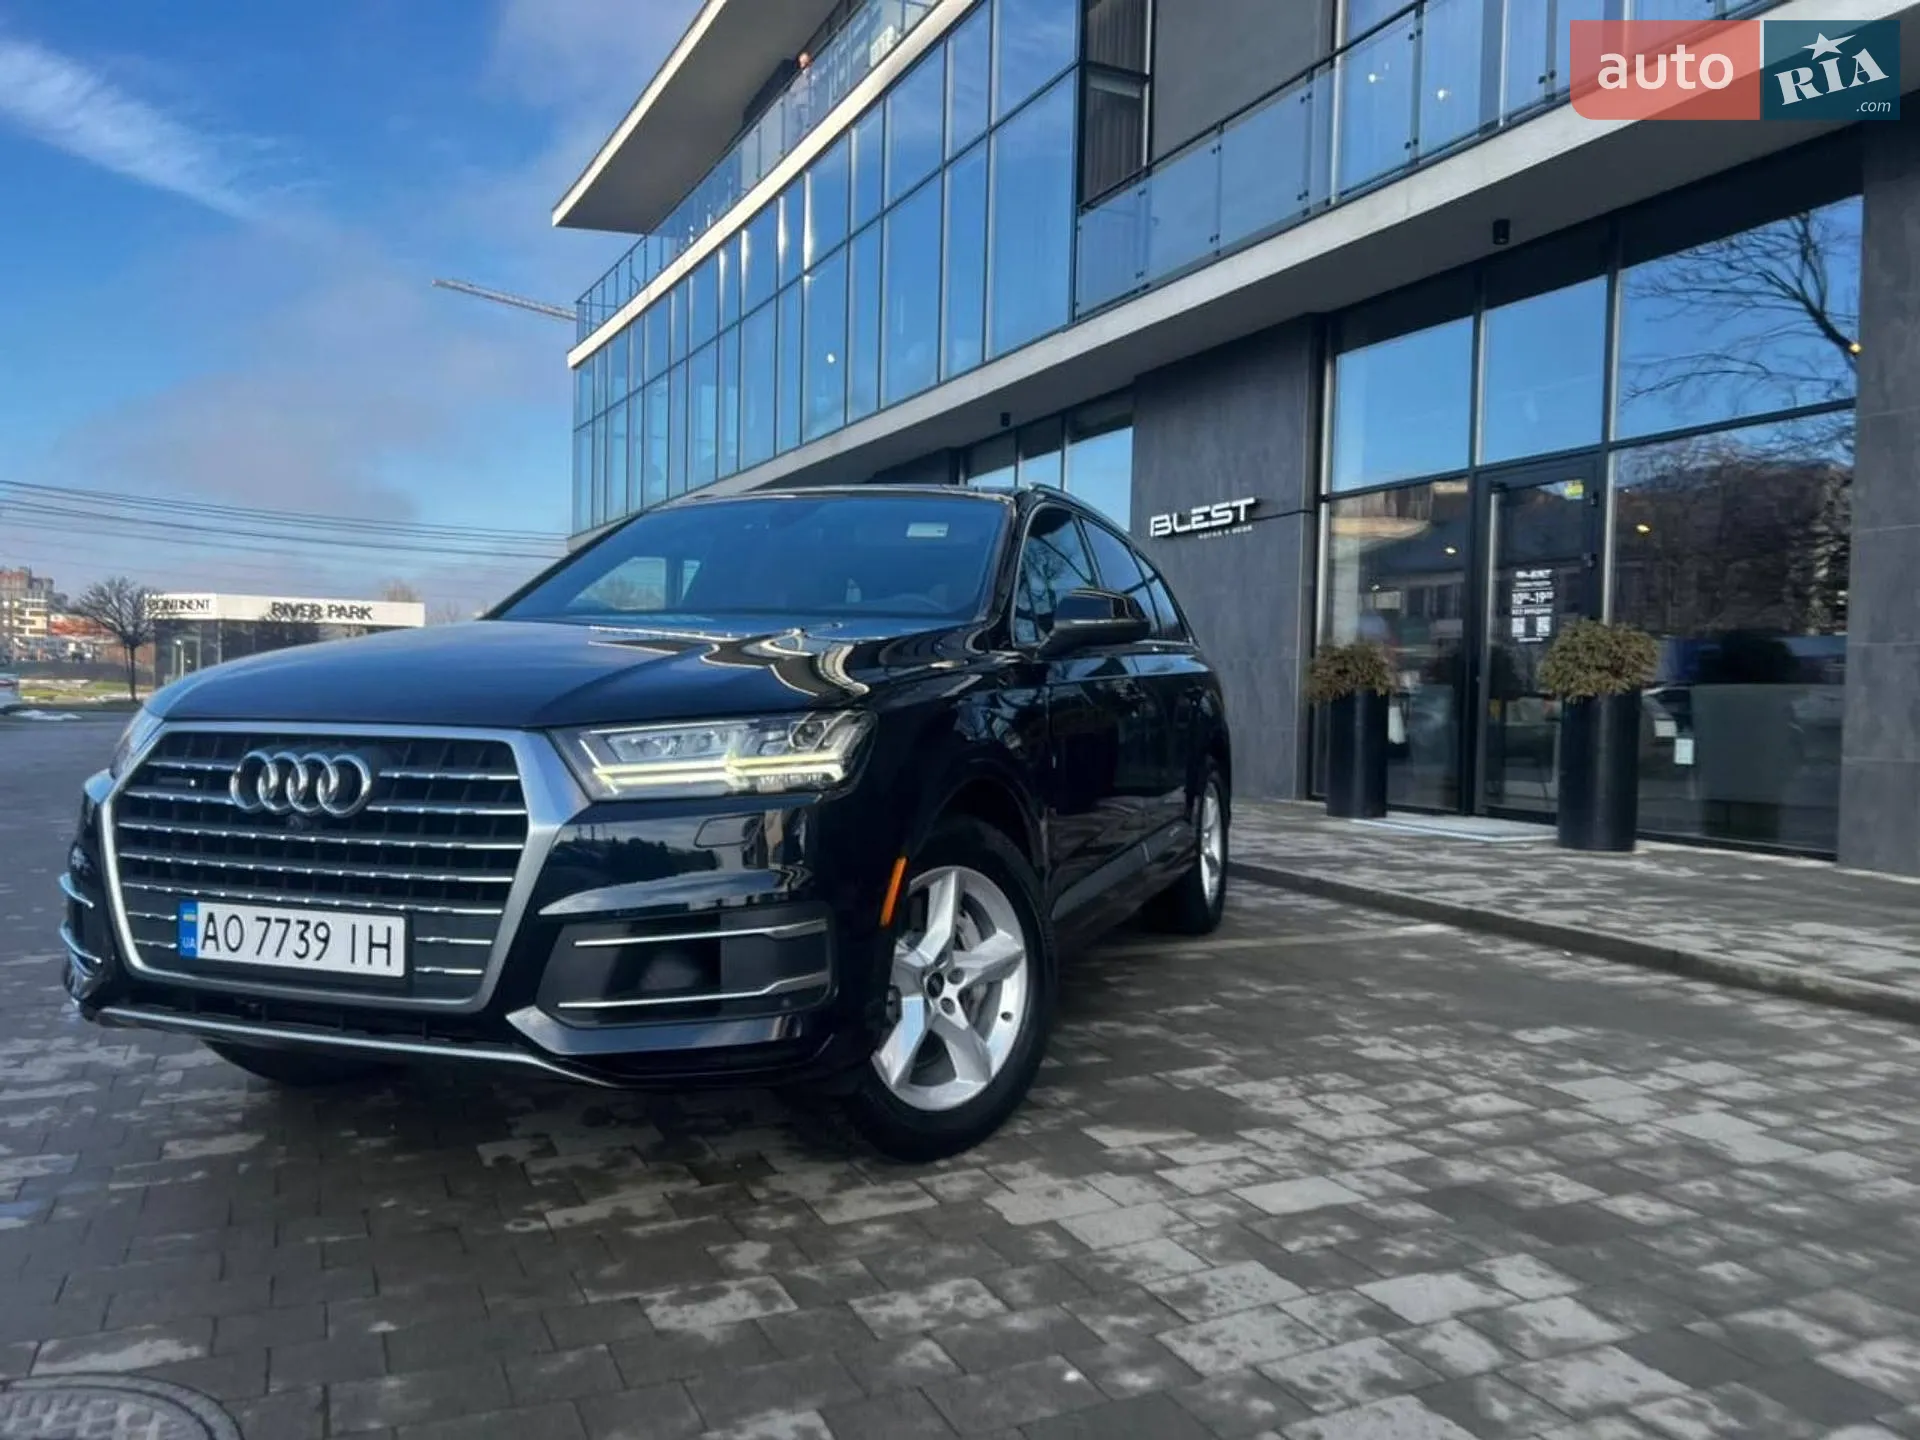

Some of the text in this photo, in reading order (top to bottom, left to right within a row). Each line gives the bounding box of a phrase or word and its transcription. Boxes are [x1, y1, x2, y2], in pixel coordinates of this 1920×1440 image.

[1150, 497, 1256, 537] BLEST
[271, 602, 373, 620] RIVER PARK
[201, 911, 392, 967] AO 7739 IH
